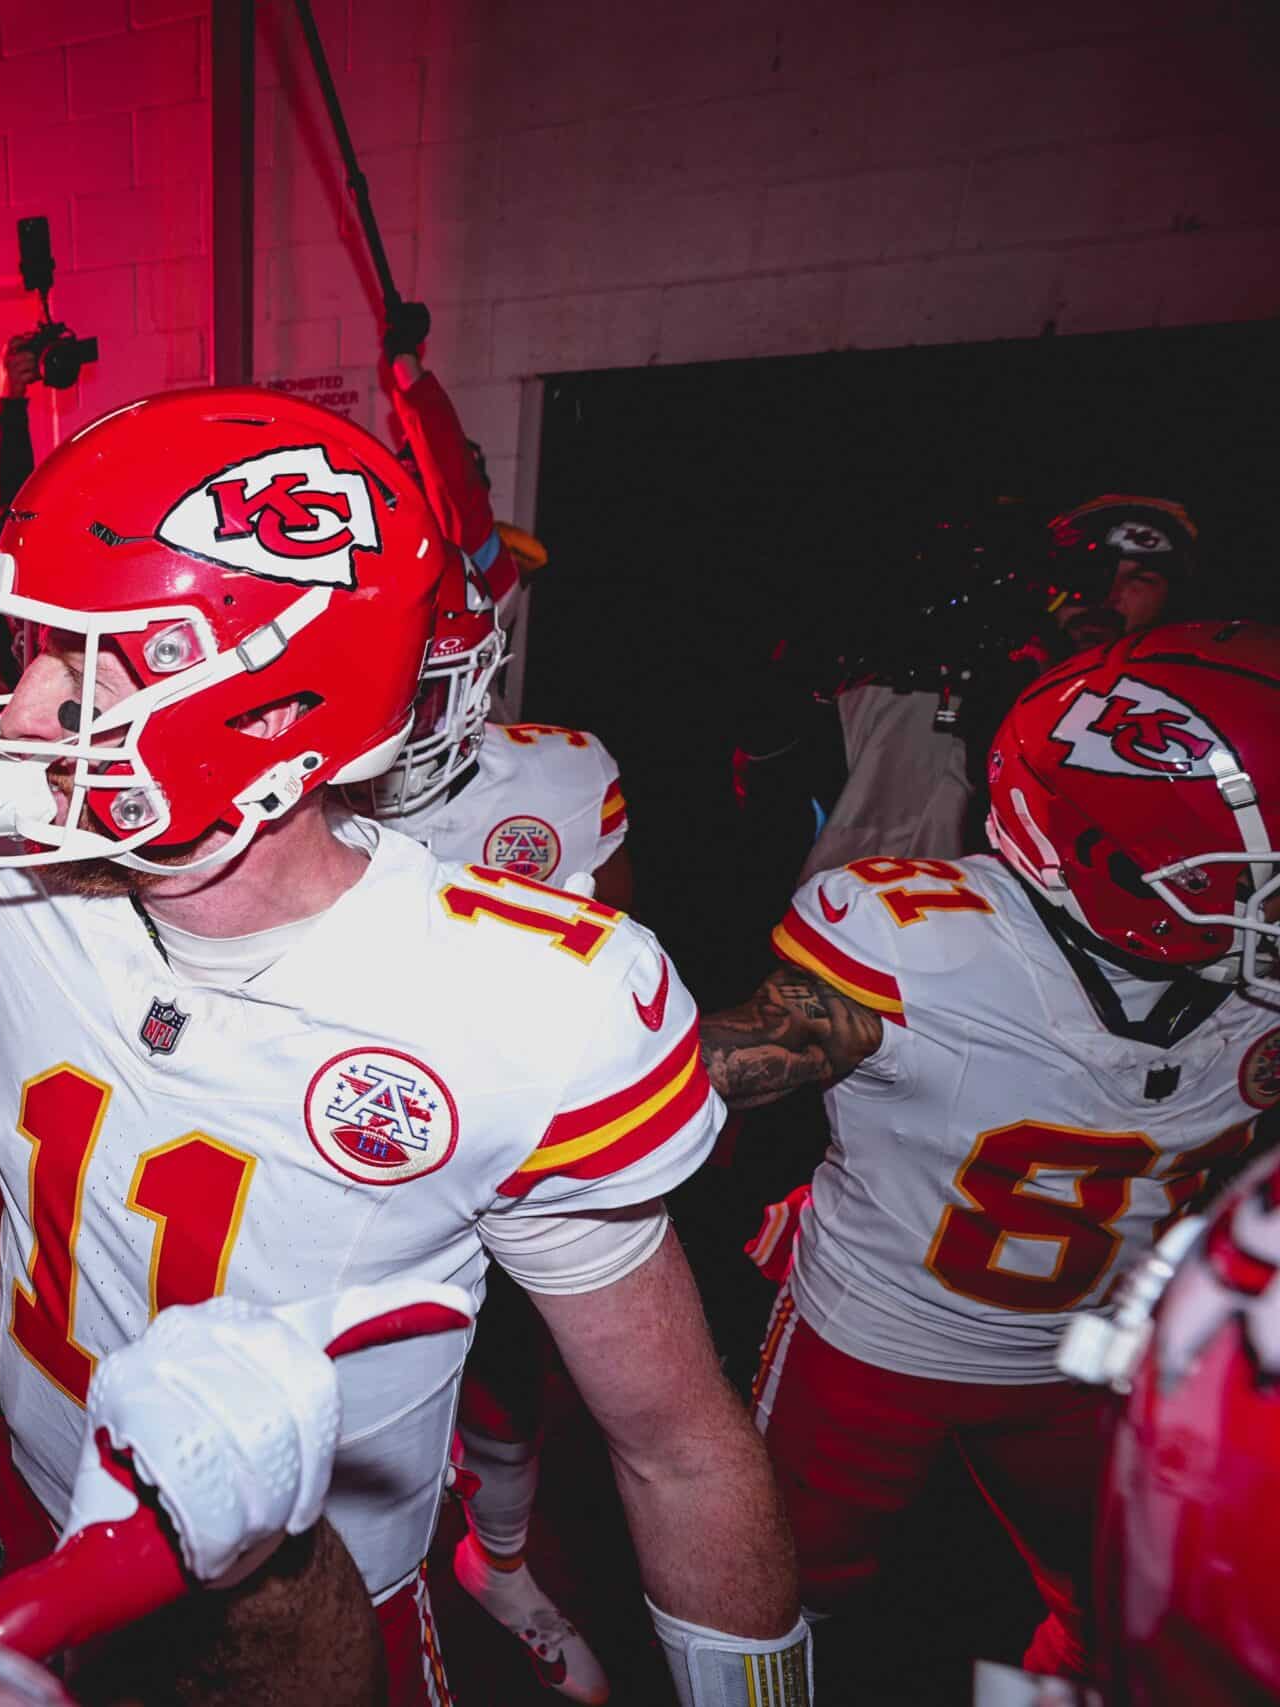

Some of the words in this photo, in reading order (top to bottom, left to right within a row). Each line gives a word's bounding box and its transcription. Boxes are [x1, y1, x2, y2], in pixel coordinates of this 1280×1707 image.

[313, 390, 359, 405] ORDER
[206, 473, 354, 559] KC
[1086, 695, 1214, 773] KC
[437, 863, 627, 965] 11
[143, 1016, 177, 1048] NFL
[357, 1135, 389, 1158] LH
[8, 1061, 258, 1412] 11
